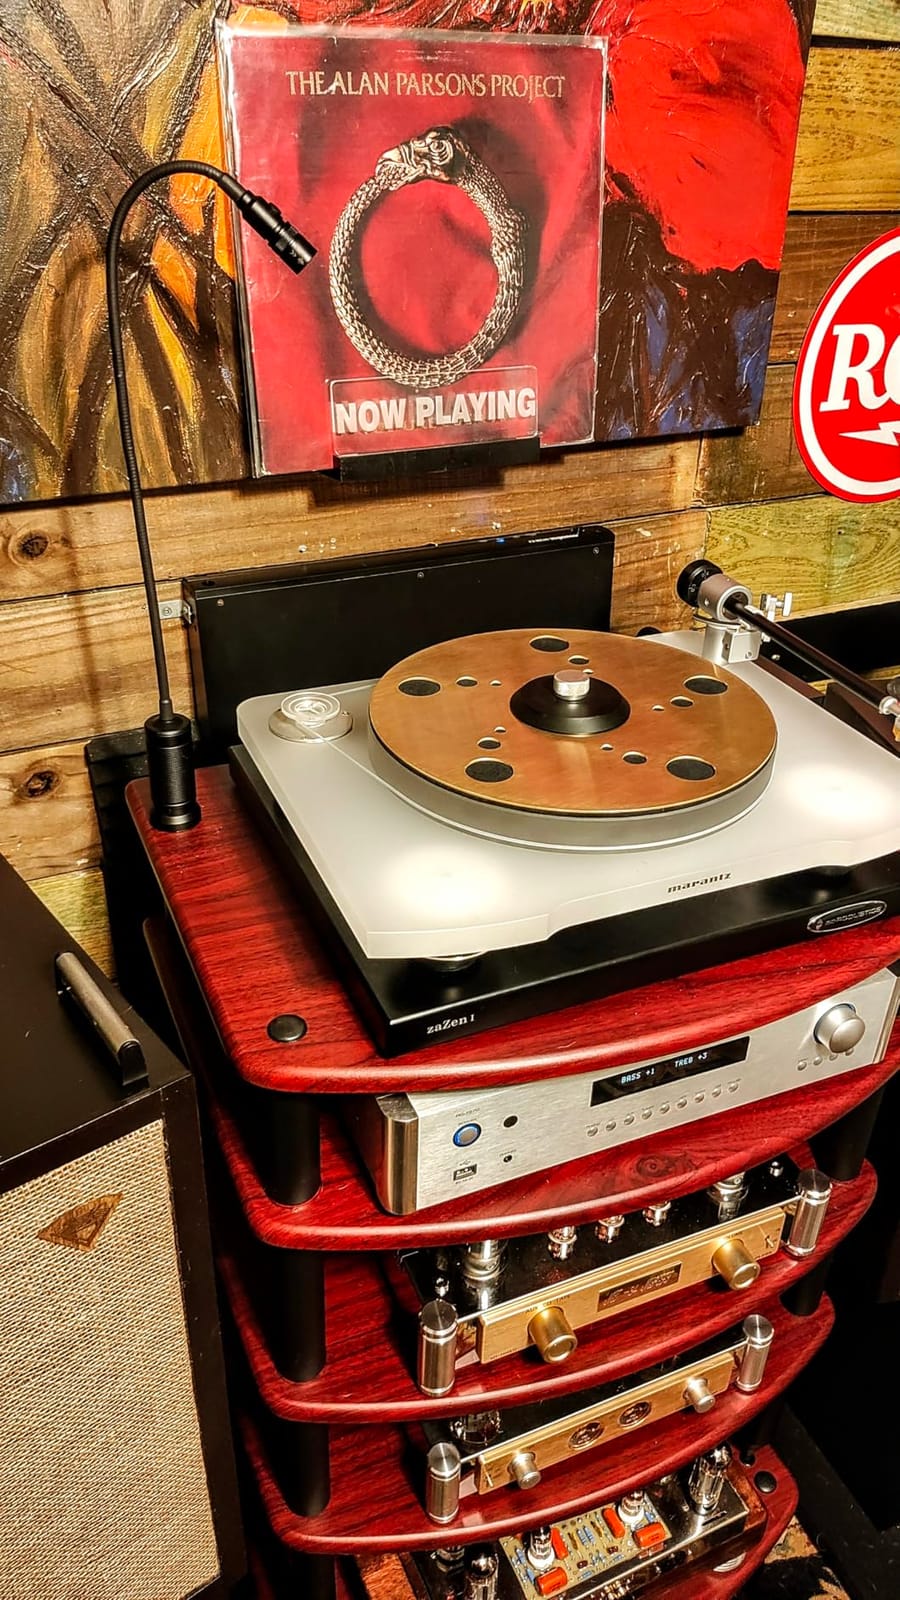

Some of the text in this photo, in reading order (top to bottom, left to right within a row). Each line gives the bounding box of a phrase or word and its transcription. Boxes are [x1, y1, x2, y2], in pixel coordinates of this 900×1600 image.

[286, 71, 565, 102] THE ALAN PARSONS PROJECT
[335, 388, 536, 434] NOW PLAYING
[667, 872, 731, 893] marantz
[426, 1016, 468, 1035] zaZen
[621, 1072, 641, 1084] BASS
[646, 1067, 655, 1076] +1
[674, 1056, 693, 1068] TREB
